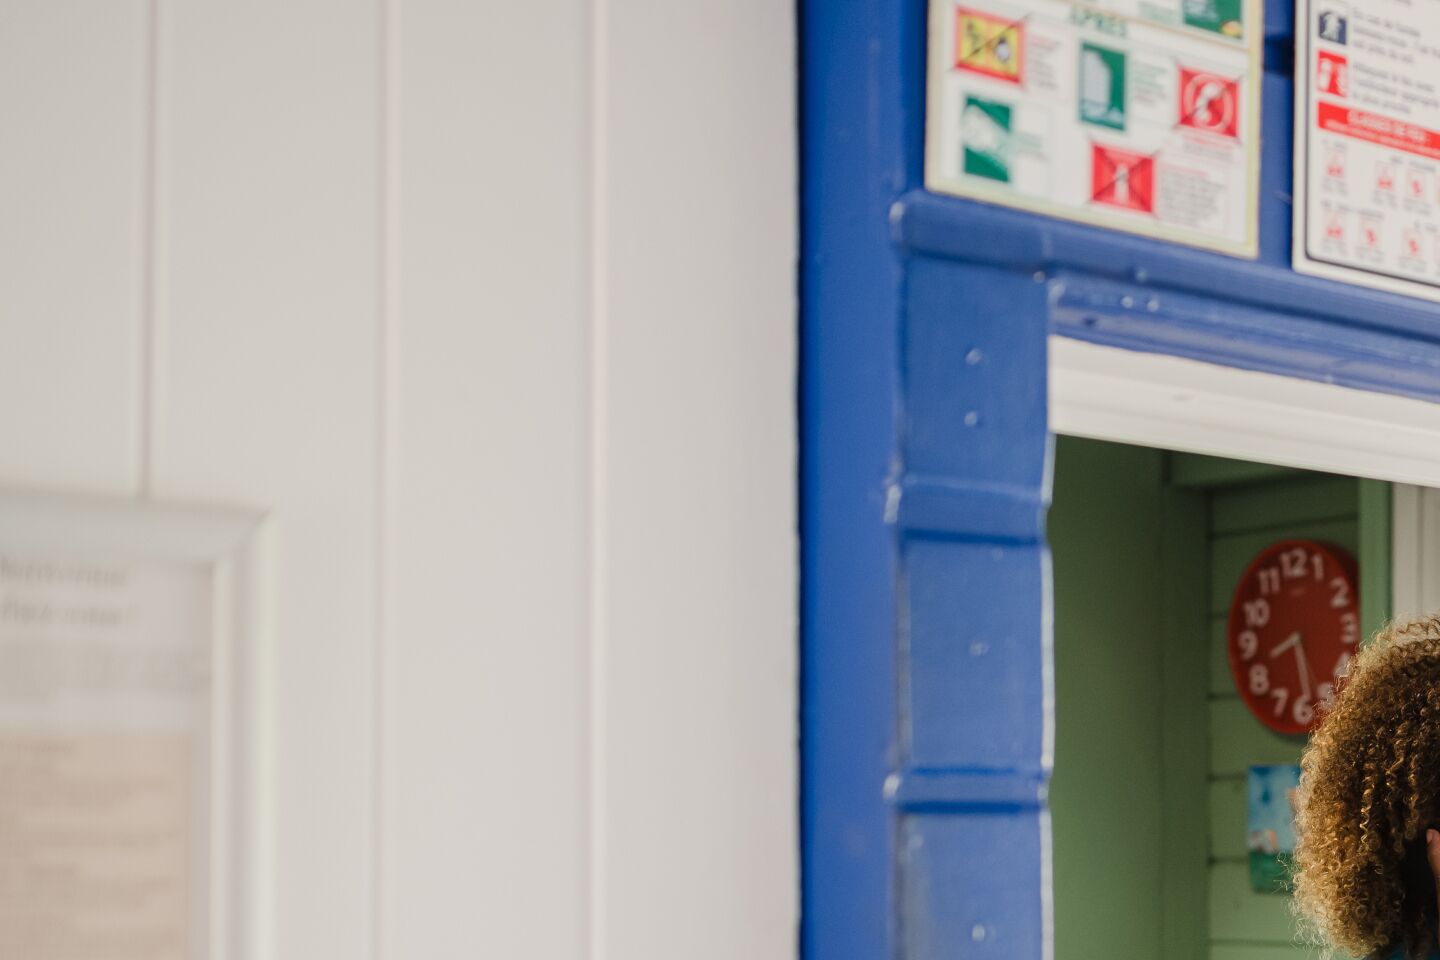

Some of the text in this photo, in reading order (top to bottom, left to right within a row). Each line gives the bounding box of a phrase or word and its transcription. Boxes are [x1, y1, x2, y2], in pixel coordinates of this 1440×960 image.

[1279, 548, 1307, 578] 12
[1311, 554, 1325, 582] 1
[1258, 566, 1281, 595] 11
[1330, 577, 1349, 608] 2
[1243, 598, 1270, 627] 10
[1340, 612, 1358, 643] 3
[1238, 630, 1258, 660] 9
[1250, 663, 1270, 695] 8
[1270, 688, 1288, 717] 7
[1293, 694, 1314, 725] 6
